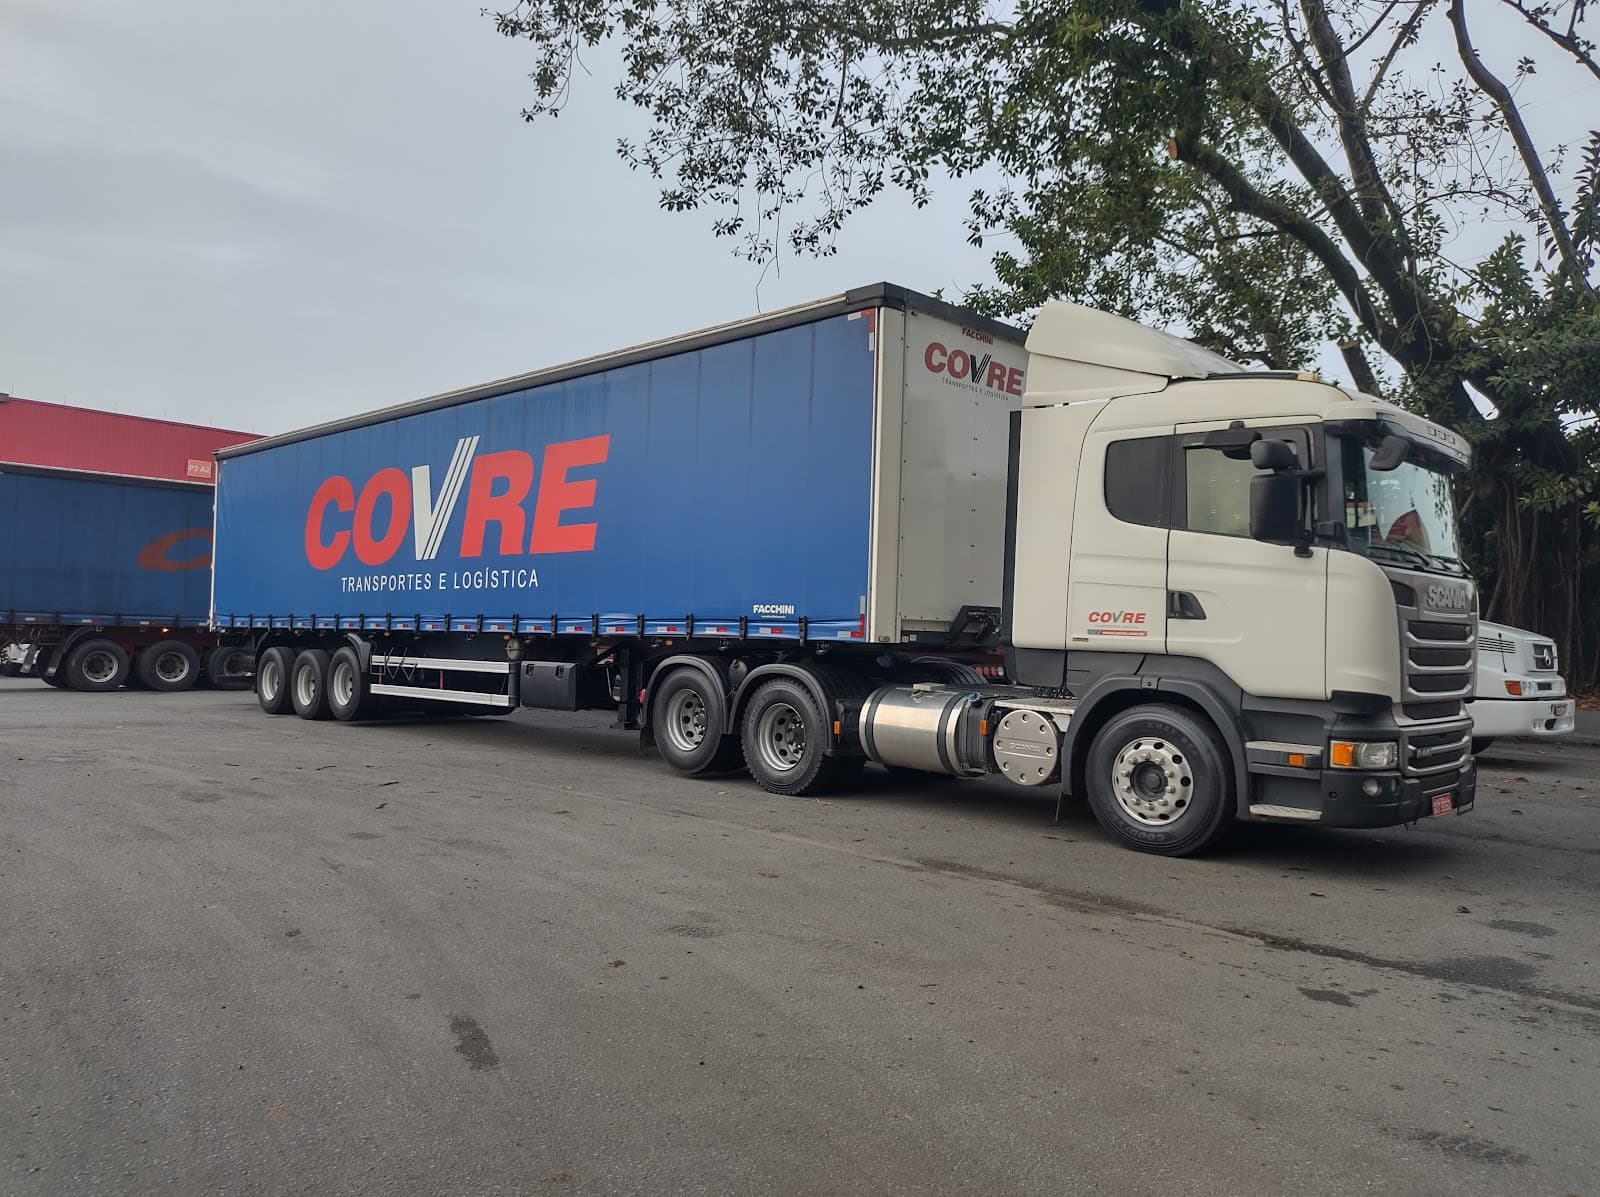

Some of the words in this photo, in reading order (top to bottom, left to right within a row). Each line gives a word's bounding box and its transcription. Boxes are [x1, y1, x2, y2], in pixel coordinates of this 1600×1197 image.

[962, 328, 993, 344] FACCHINI
[925, 342, 1024, 396] COVRE
[304, 435, 611, 571] COVRE
[341, 572, 432, 593] TRANSPORTES
[438, 572, 447, 590] E
[453, 566, 539, 590] LOGÍSTICA
[753, 604, 795, 615] FACCHINI
[1427, 584, 1466, 610] SCANIA
[1088, 611, 1147, 624] COVRE
